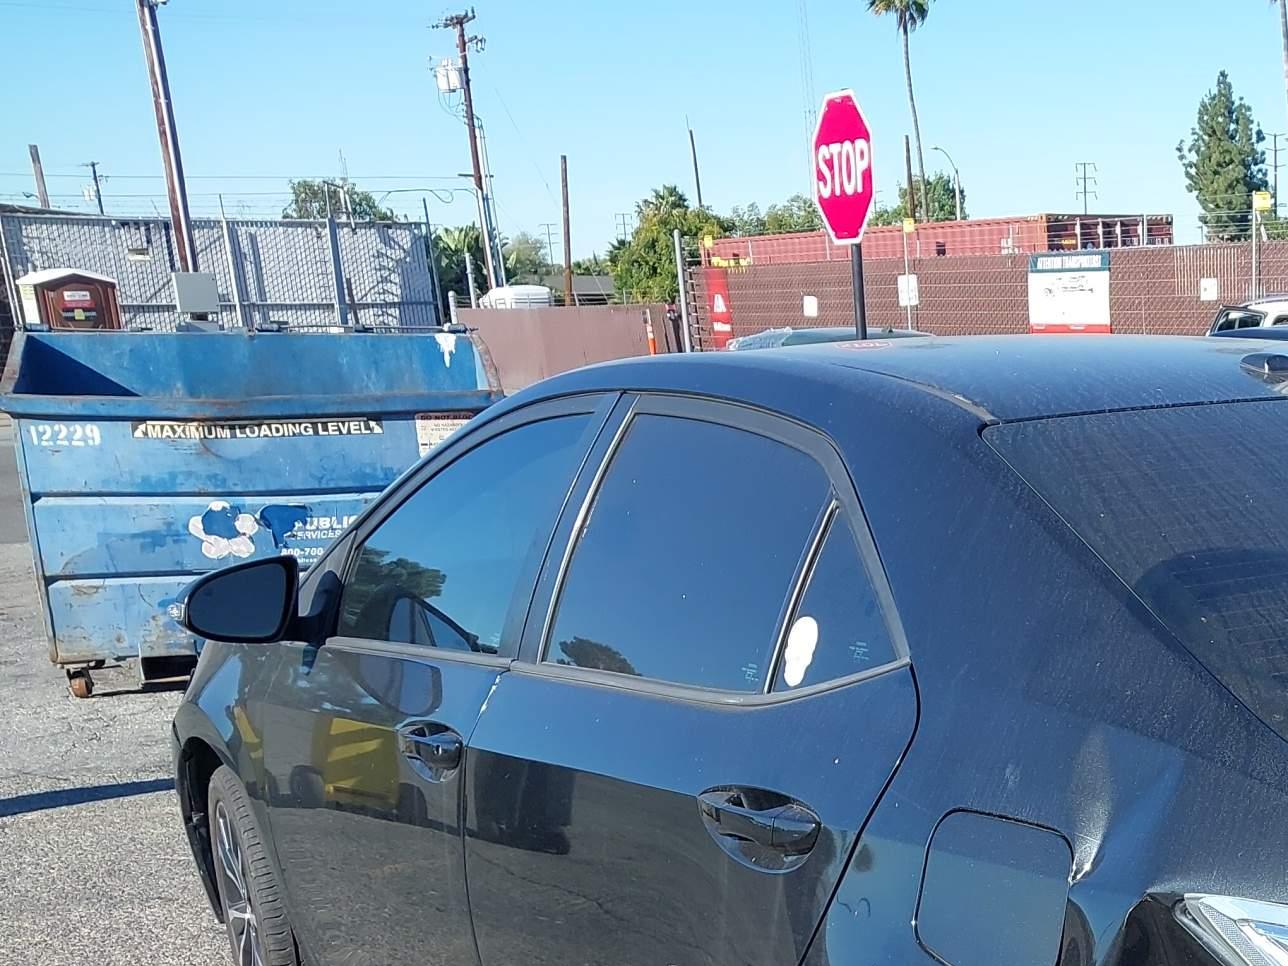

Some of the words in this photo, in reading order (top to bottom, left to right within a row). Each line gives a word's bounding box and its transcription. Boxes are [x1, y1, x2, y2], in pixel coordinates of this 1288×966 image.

[818, 138, 870, 199] STOP
[30, 423, 101, 446] 12229
[148, 422, 231, 440] MAXIMUM
[236, 422, 314, 439] LOADING
[318, 420, 371, 435] LEVEL
